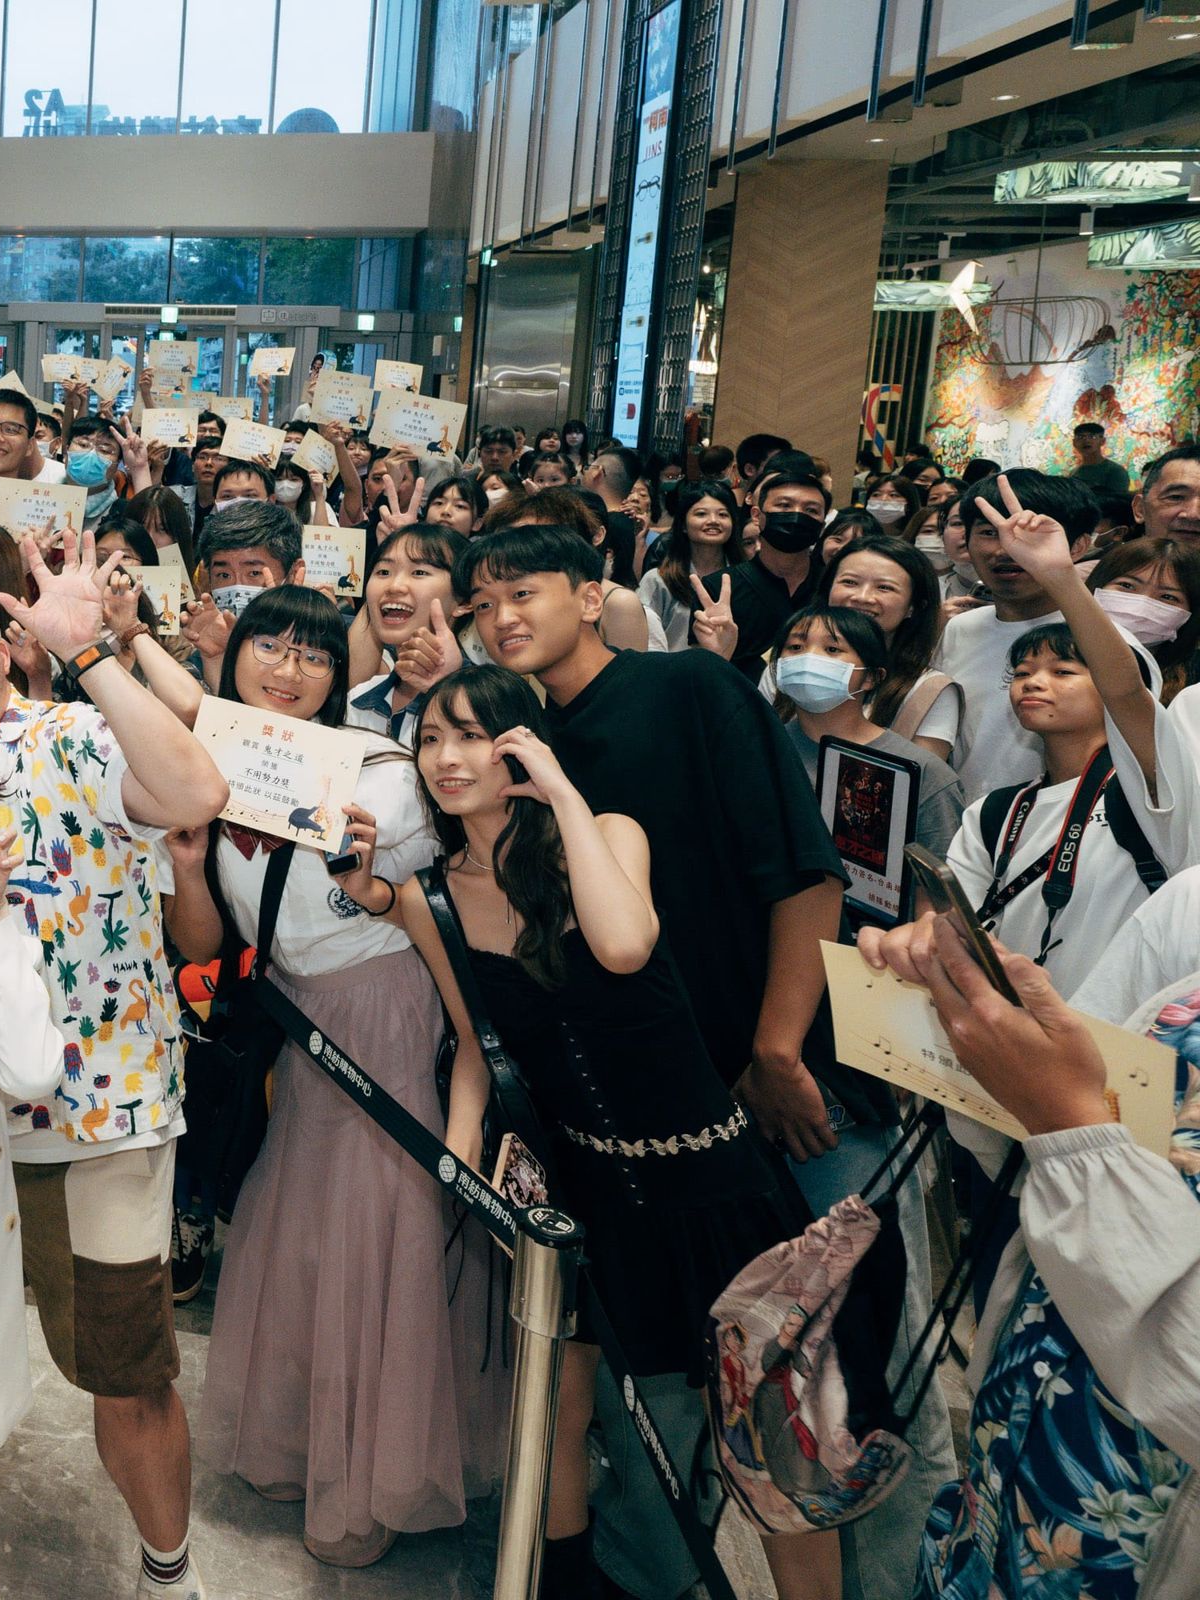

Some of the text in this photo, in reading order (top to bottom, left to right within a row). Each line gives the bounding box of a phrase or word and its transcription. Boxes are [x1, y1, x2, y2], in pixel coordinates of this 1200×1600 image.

[261, 723, 296, 744] 獎狀
[263, 744, 306, 764] 鬼才之道
[1008, 800, 1030, 843] Canon
[1057, 841, 1077, 873] EOS
[323, 1042, 373, 1098] 南紡購物中心
